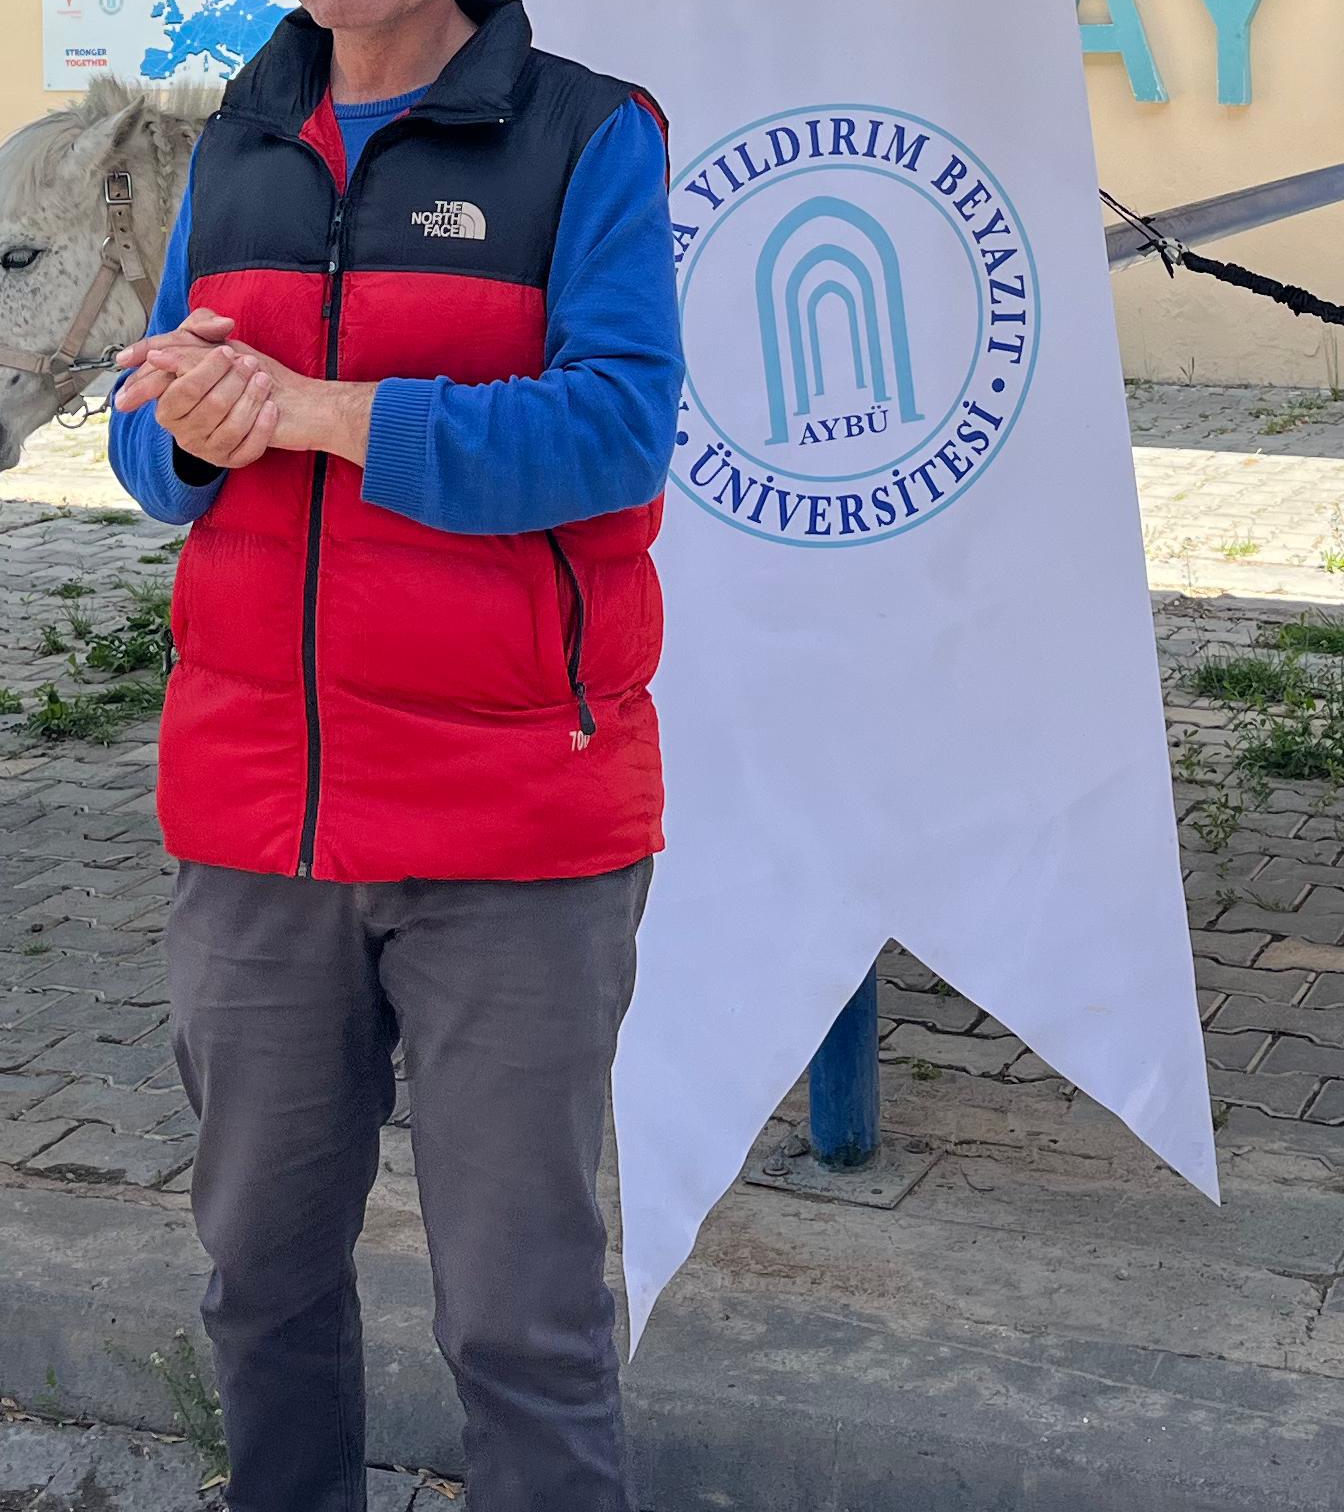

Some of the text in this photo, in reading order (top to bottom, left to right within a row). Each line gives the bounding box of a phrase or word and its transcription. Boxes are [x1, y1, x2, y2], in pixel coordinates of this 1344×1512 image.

[65, 48, 107, 56] STRONGER
[65, 58, 108, 67] TOGETHER
[435, 200, 463, 213] THE
[411, 211, 461, 225] NORTH
[424, 224, 461, 237] FACE
[684, 117, 1027, 364] YILDIRIM BEYAZIT
[798, 405, 890, 446] AYBÜ
[689, 400, 1004, 536] ÜNİVERSİTESİ
